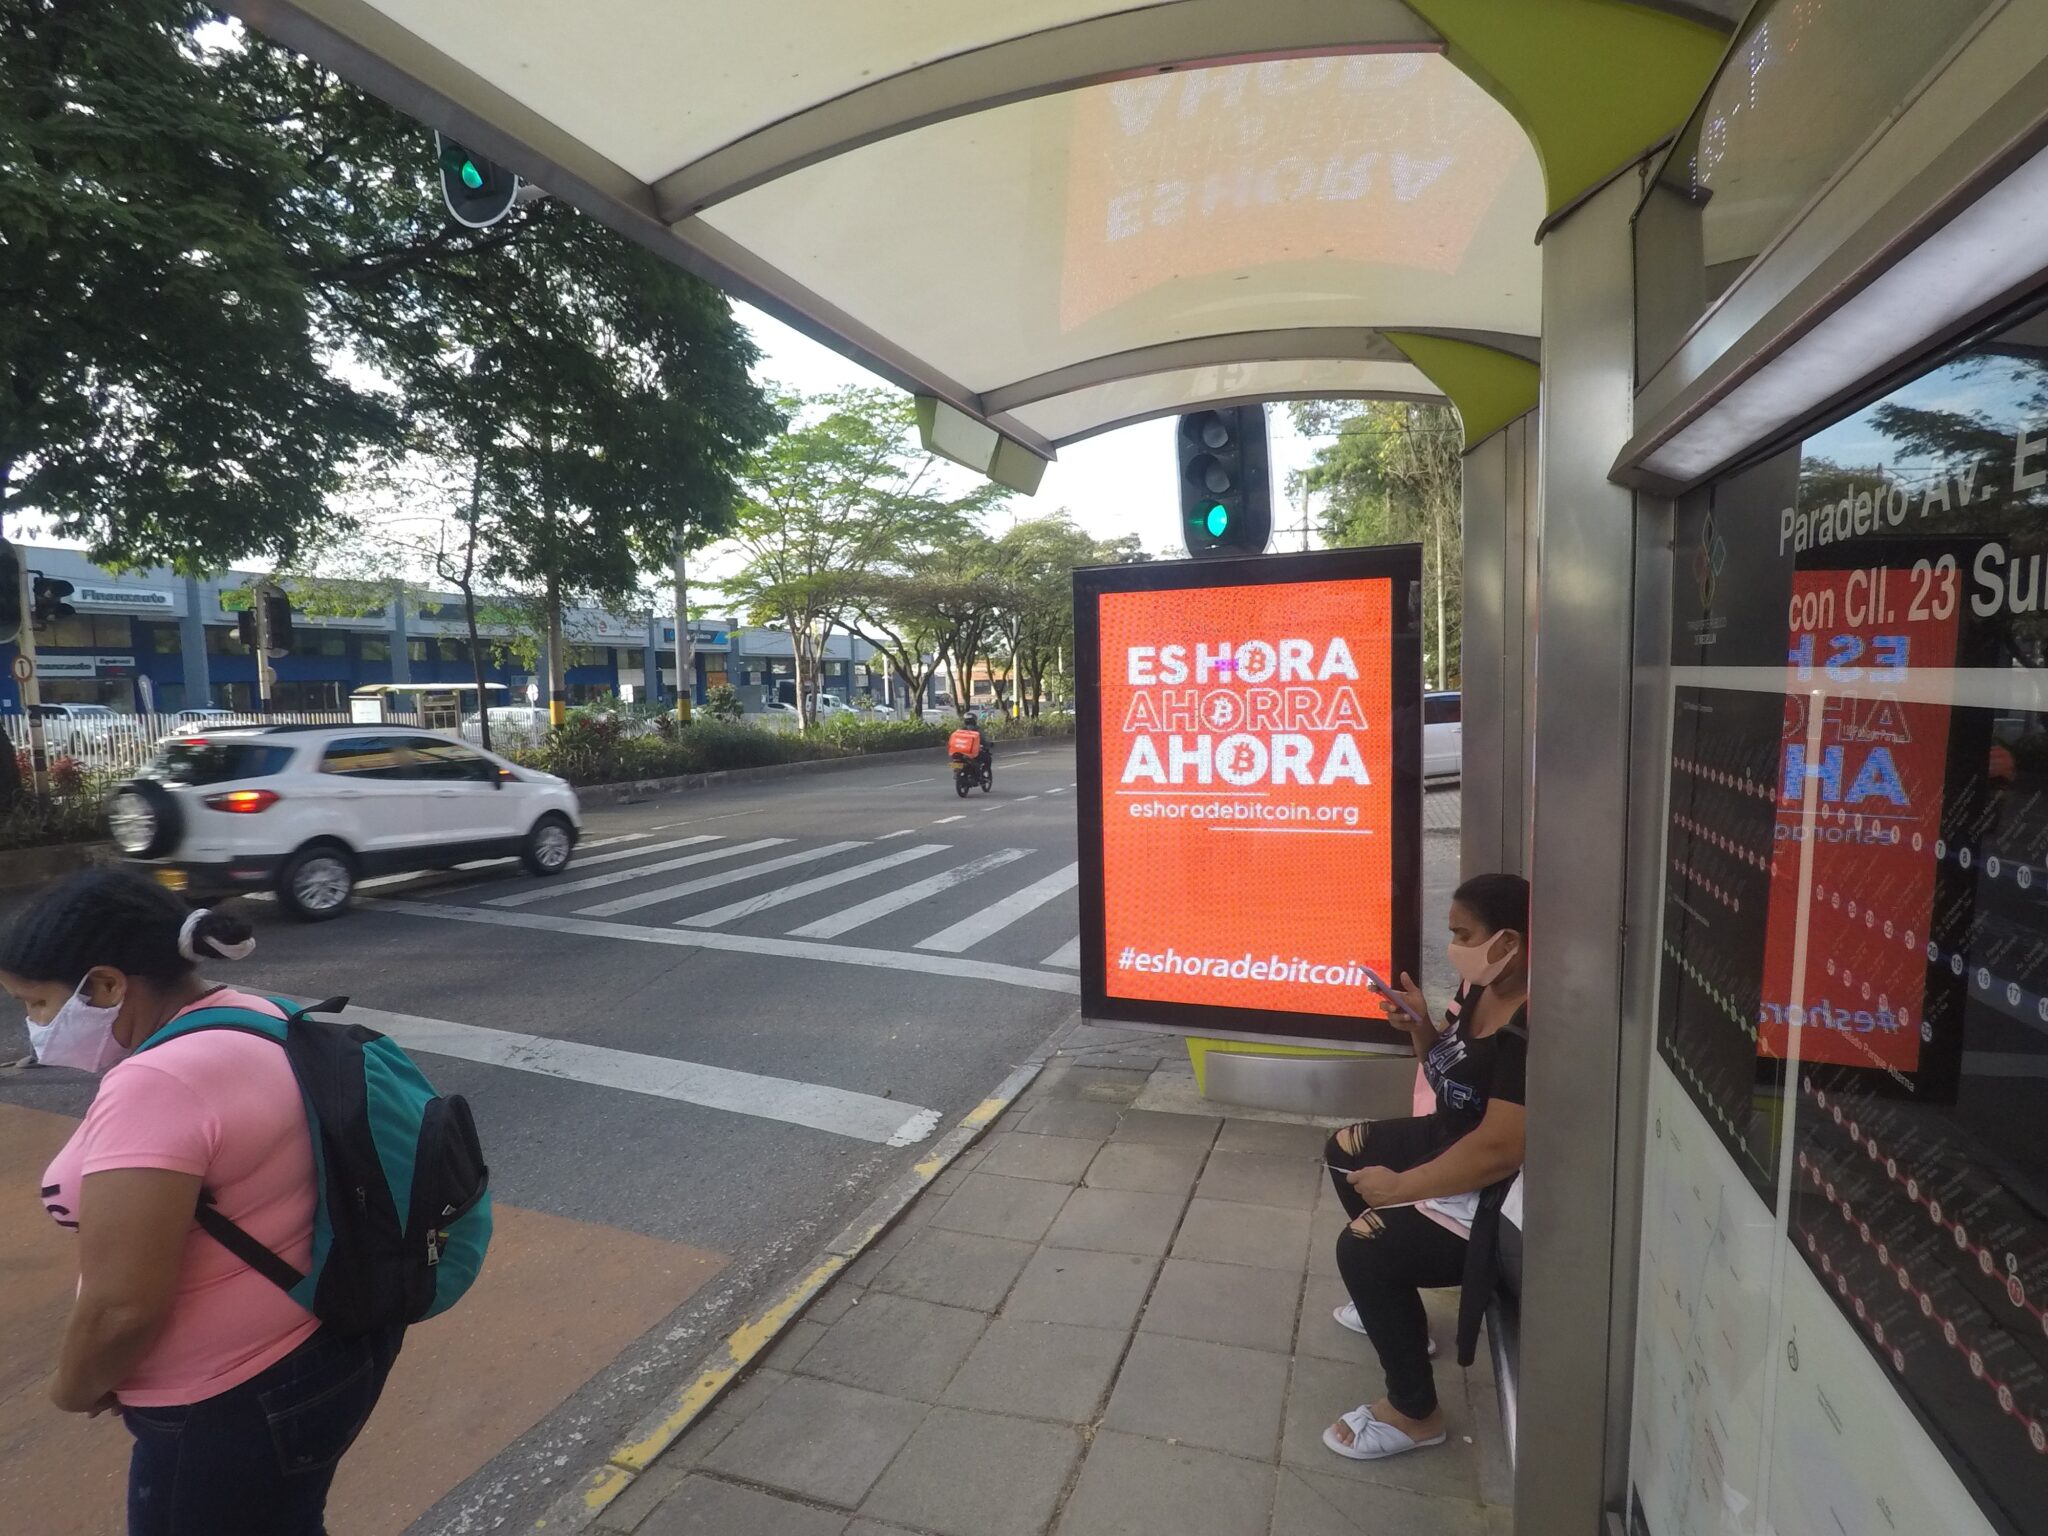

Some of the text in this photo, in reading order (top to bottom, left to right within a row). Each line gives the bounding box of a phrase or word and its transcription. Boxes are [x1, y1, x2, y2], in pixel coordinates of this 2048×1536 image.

[1779, 481, 1908, 557] Paradero
[1921, 459, 1991, 518] Av.
[1788, 542, 2048, 632] con Cll. 23 Su
[1127, 637, 1360, 686] ES HORA
[1122, 686, 1369, 733] AHORRA
[1120, 733, 1371, 786] AHORA
[1129, 801, 1359, 825] eshoradebitcoin.org
